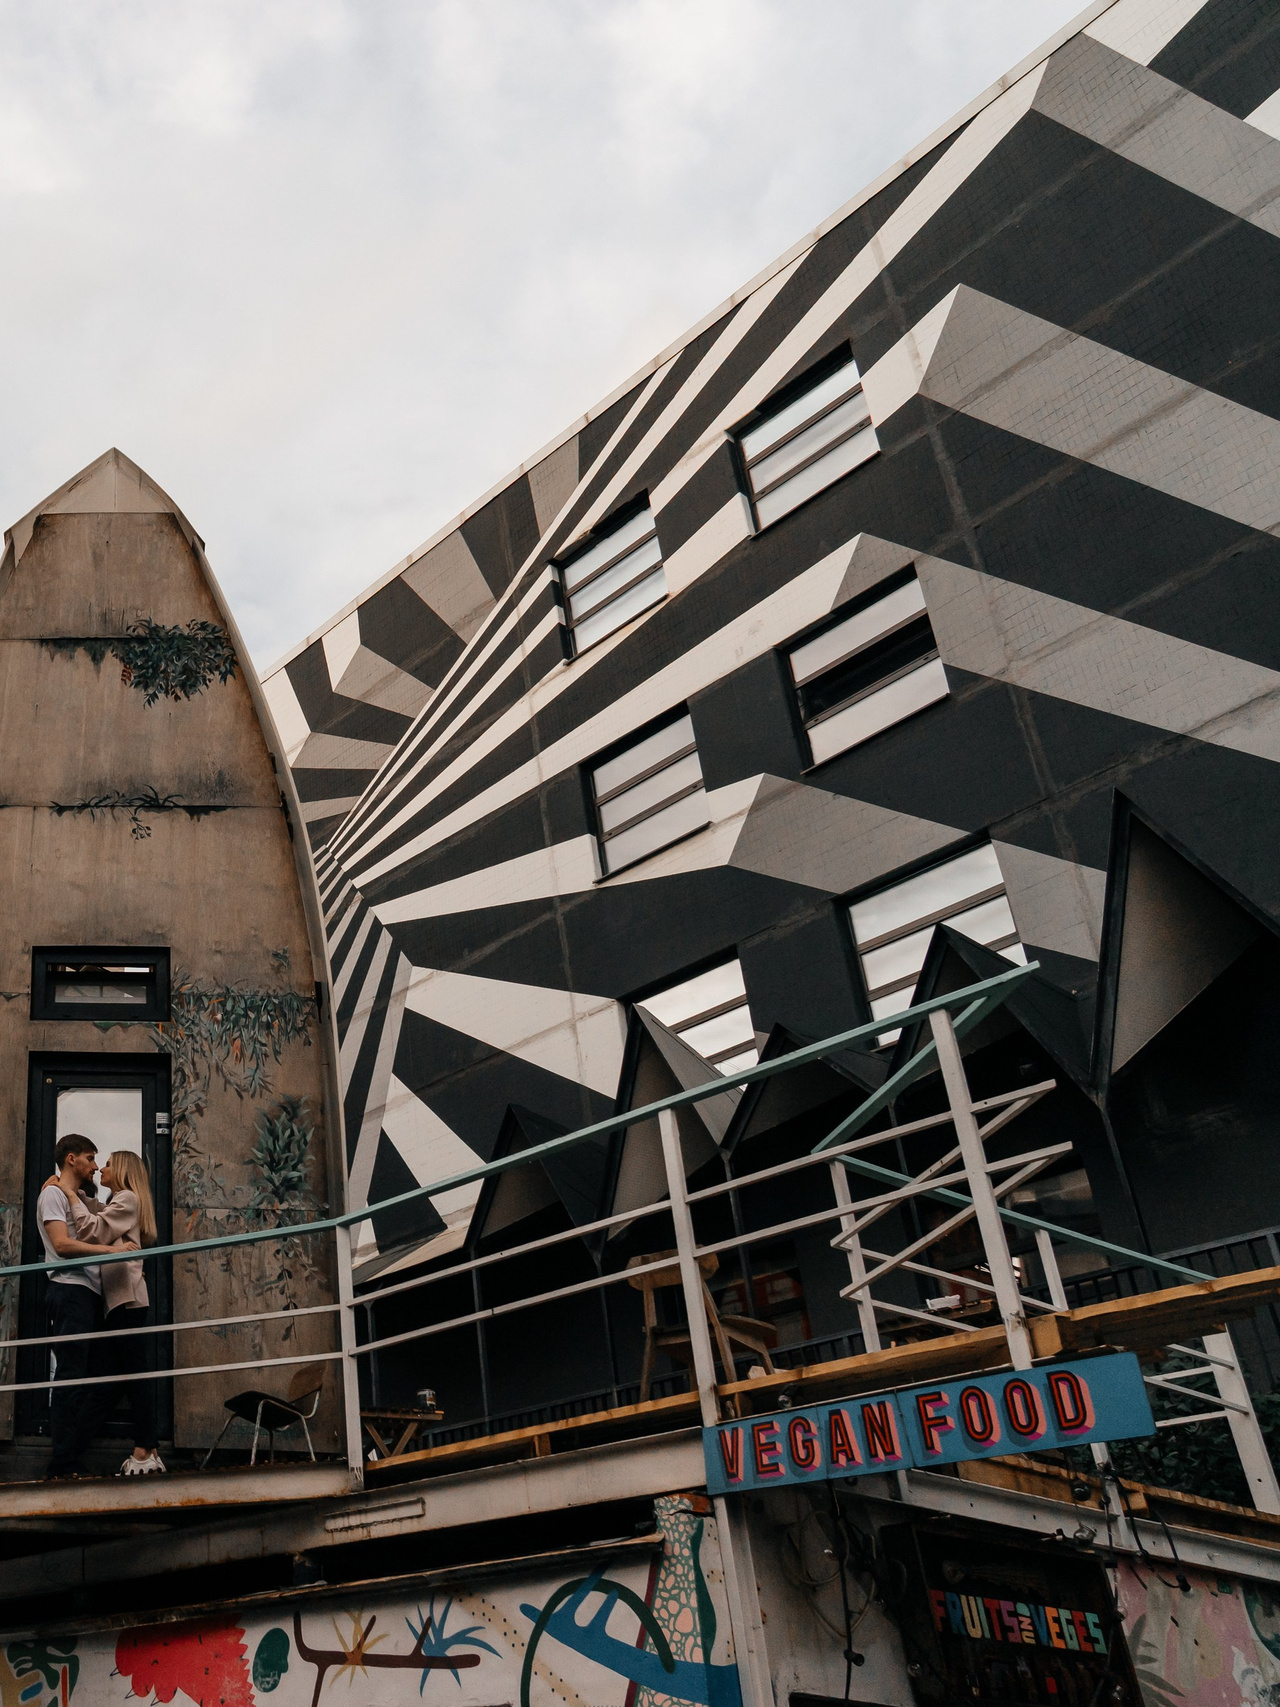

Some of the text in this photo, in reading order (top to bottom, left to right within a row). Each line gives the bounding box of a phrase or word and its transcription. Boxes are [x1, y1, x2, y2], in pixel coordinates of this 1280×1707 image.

[719, 1370, 1095, 1483] VEGAN FOOD
[929, 1589, 1023, 1644] FRUITS
[1028, 1604, 1108, 1655] VEGES
